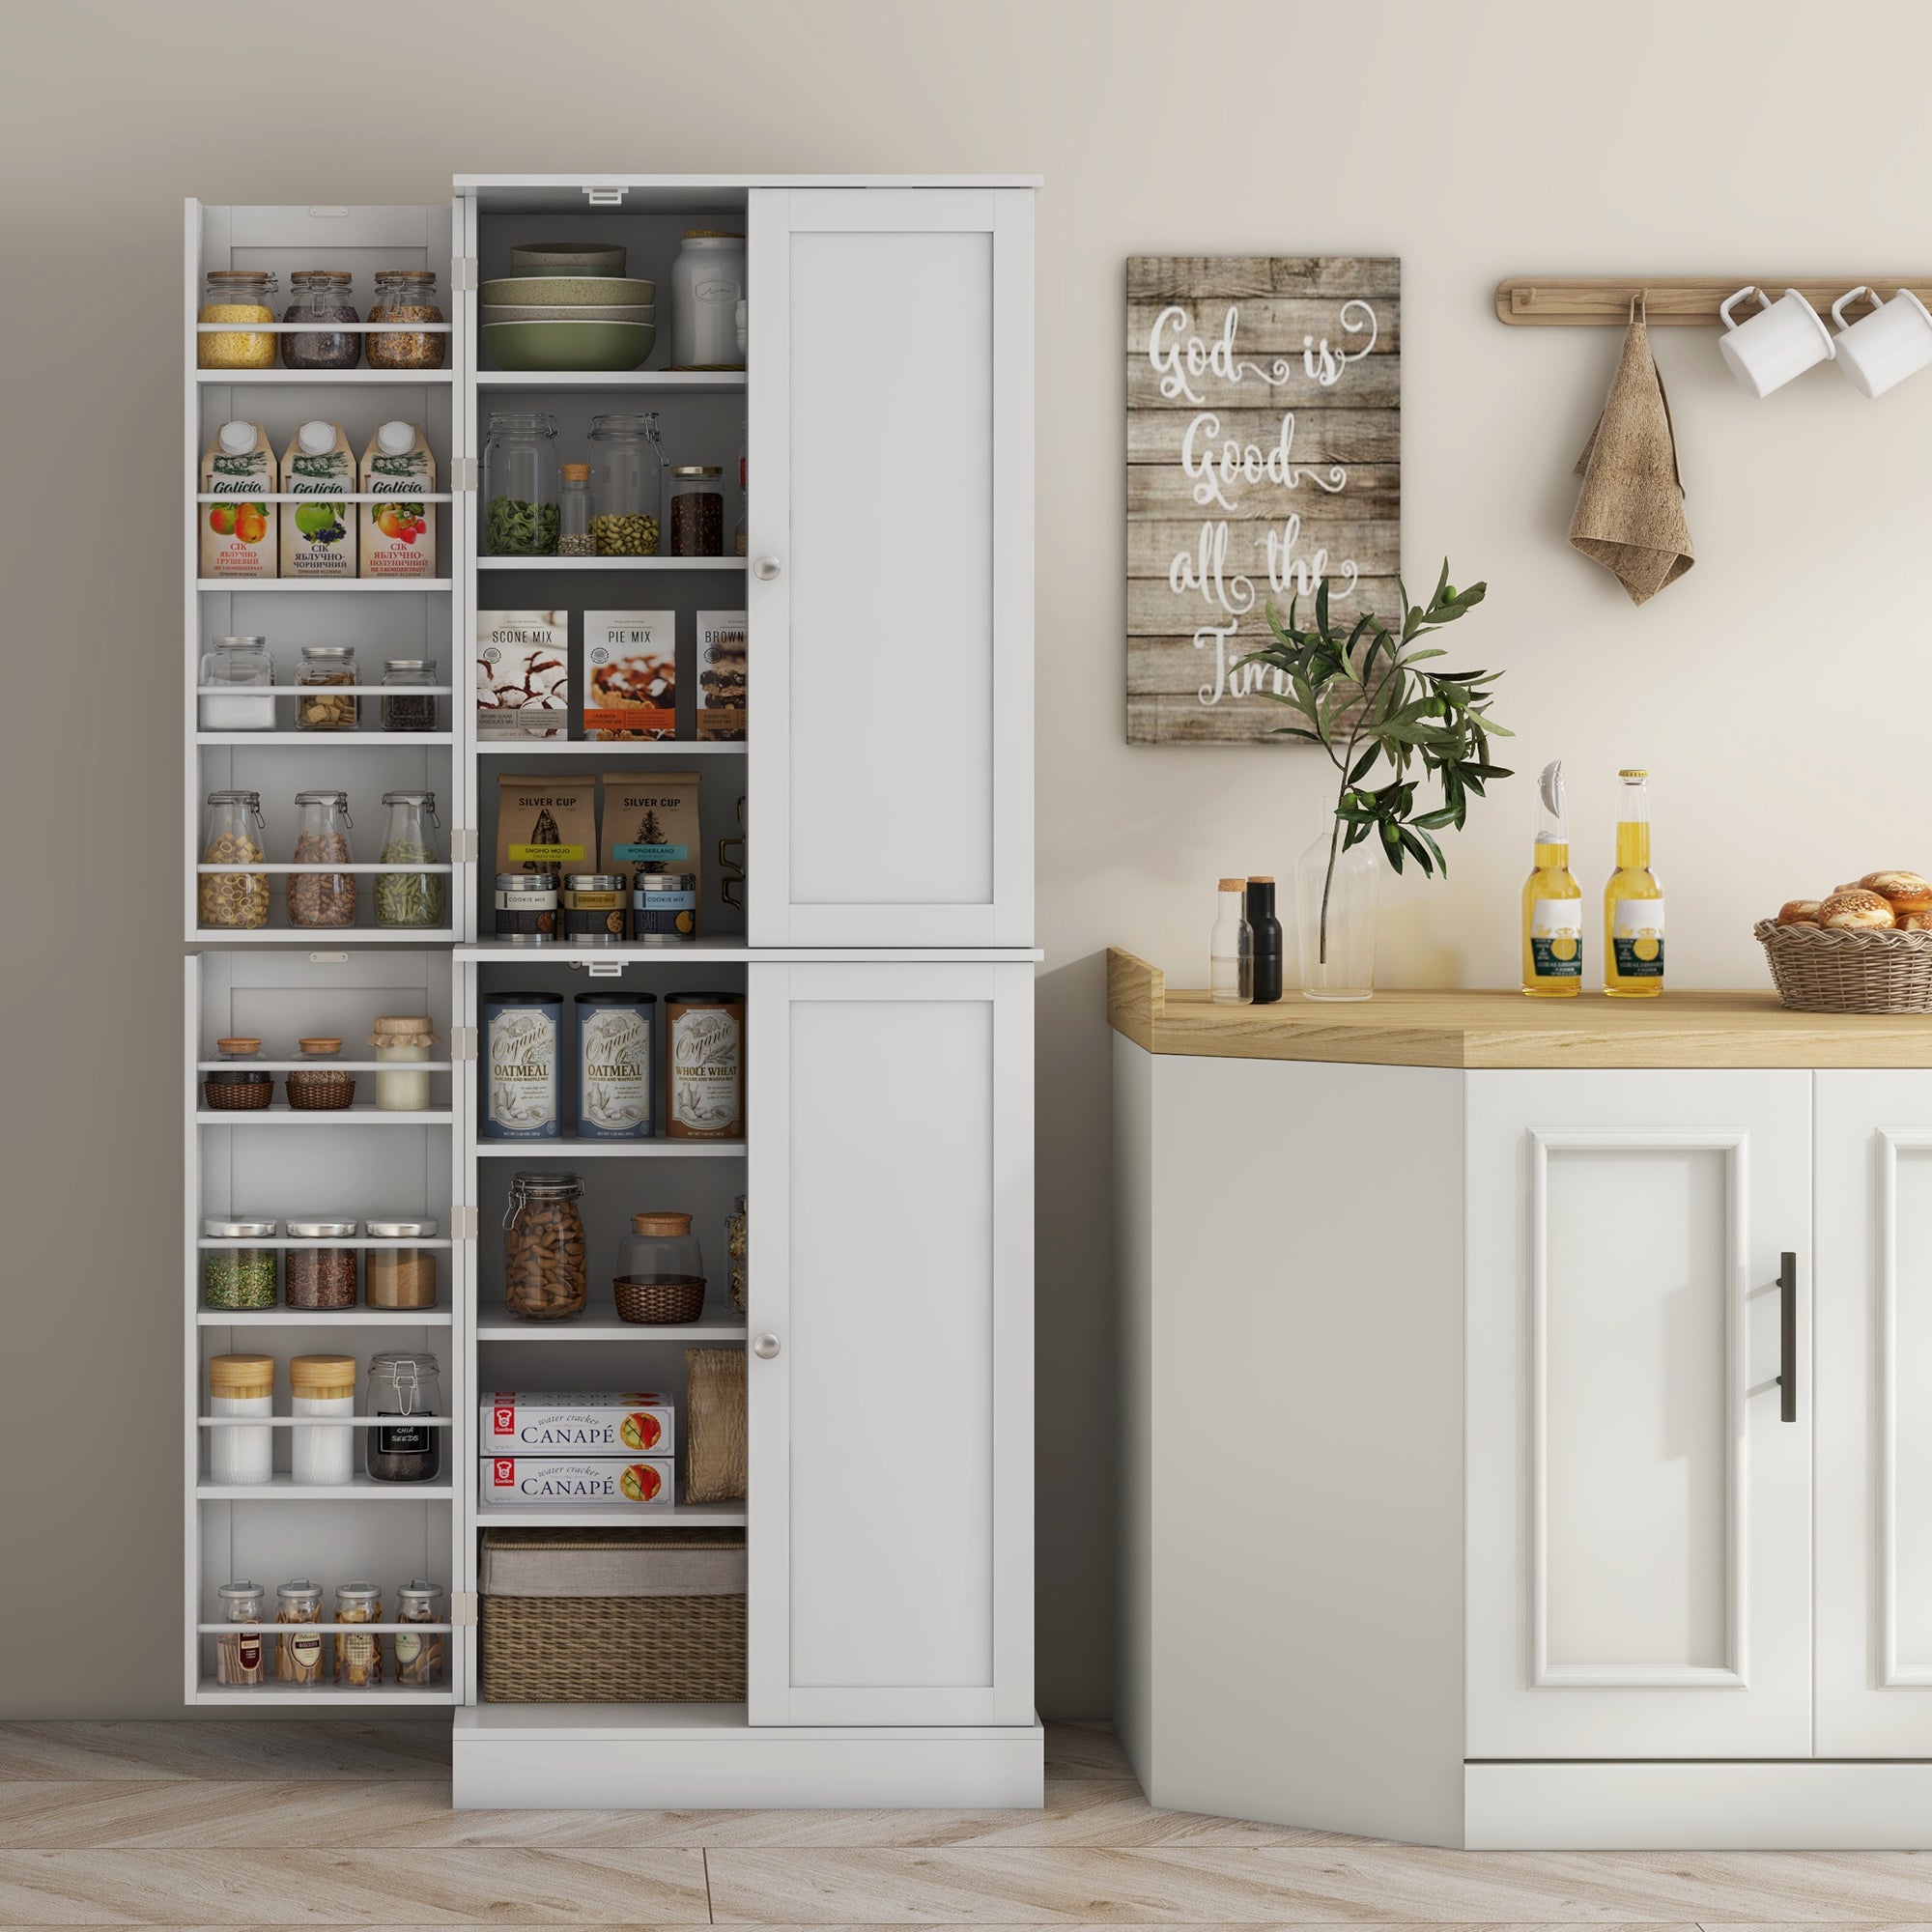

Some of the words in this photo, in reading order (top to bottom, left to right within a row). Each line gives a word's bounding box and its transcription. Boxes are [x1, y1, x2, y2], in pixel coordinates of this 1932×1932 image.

[1150, 305, 1290, 404] God
[1303, 299, 1378, 386] is
[1181, 412, 1347, 511] Good
[213, 481, 266, 494] Galicia
[293, 483, 347, 494] Galicia
[372, 481, 426, 494] Galicia
[1169, 520, 1256, 615] all
[1255, 513, 1358, 600] the
[492, 631, 527, 643] SCONE
[532, 631, 553, 643] MIX
[609, 631, 625, 643] PIE
[632, 631, 651, 643] MIX
[705, 631, 744, 643] BROWN
[519, 798, 553, 807] SILVER
[556, 798, 577, 807] CUP
[623, 798, 657, 807] SILVER
[660, 798, 681, 808] CUP
[492, 1022, 548, 1063] Organic
[585, 1022, 641, 1063] Organic
[676, 1022, 732, 1063] Organic
[494, 1065, 549, 1077] OATMEAL
[587, 1065, 642, 1077] OATMEAL
[675, 1065, 706, 1076] WHOLE
[708, 1065, 737, 1076] WHEAT
[538, 1415, 563, 1426] water
[566, 1414, 600, 1426] cracker
[521, 1425, 614, 1444] CANAPÉ
[538, 1466, 563, 1477] water
[566, 1465, 600, 1477] cracker
[521, 1476, 614, 1495] CANAPÉ
